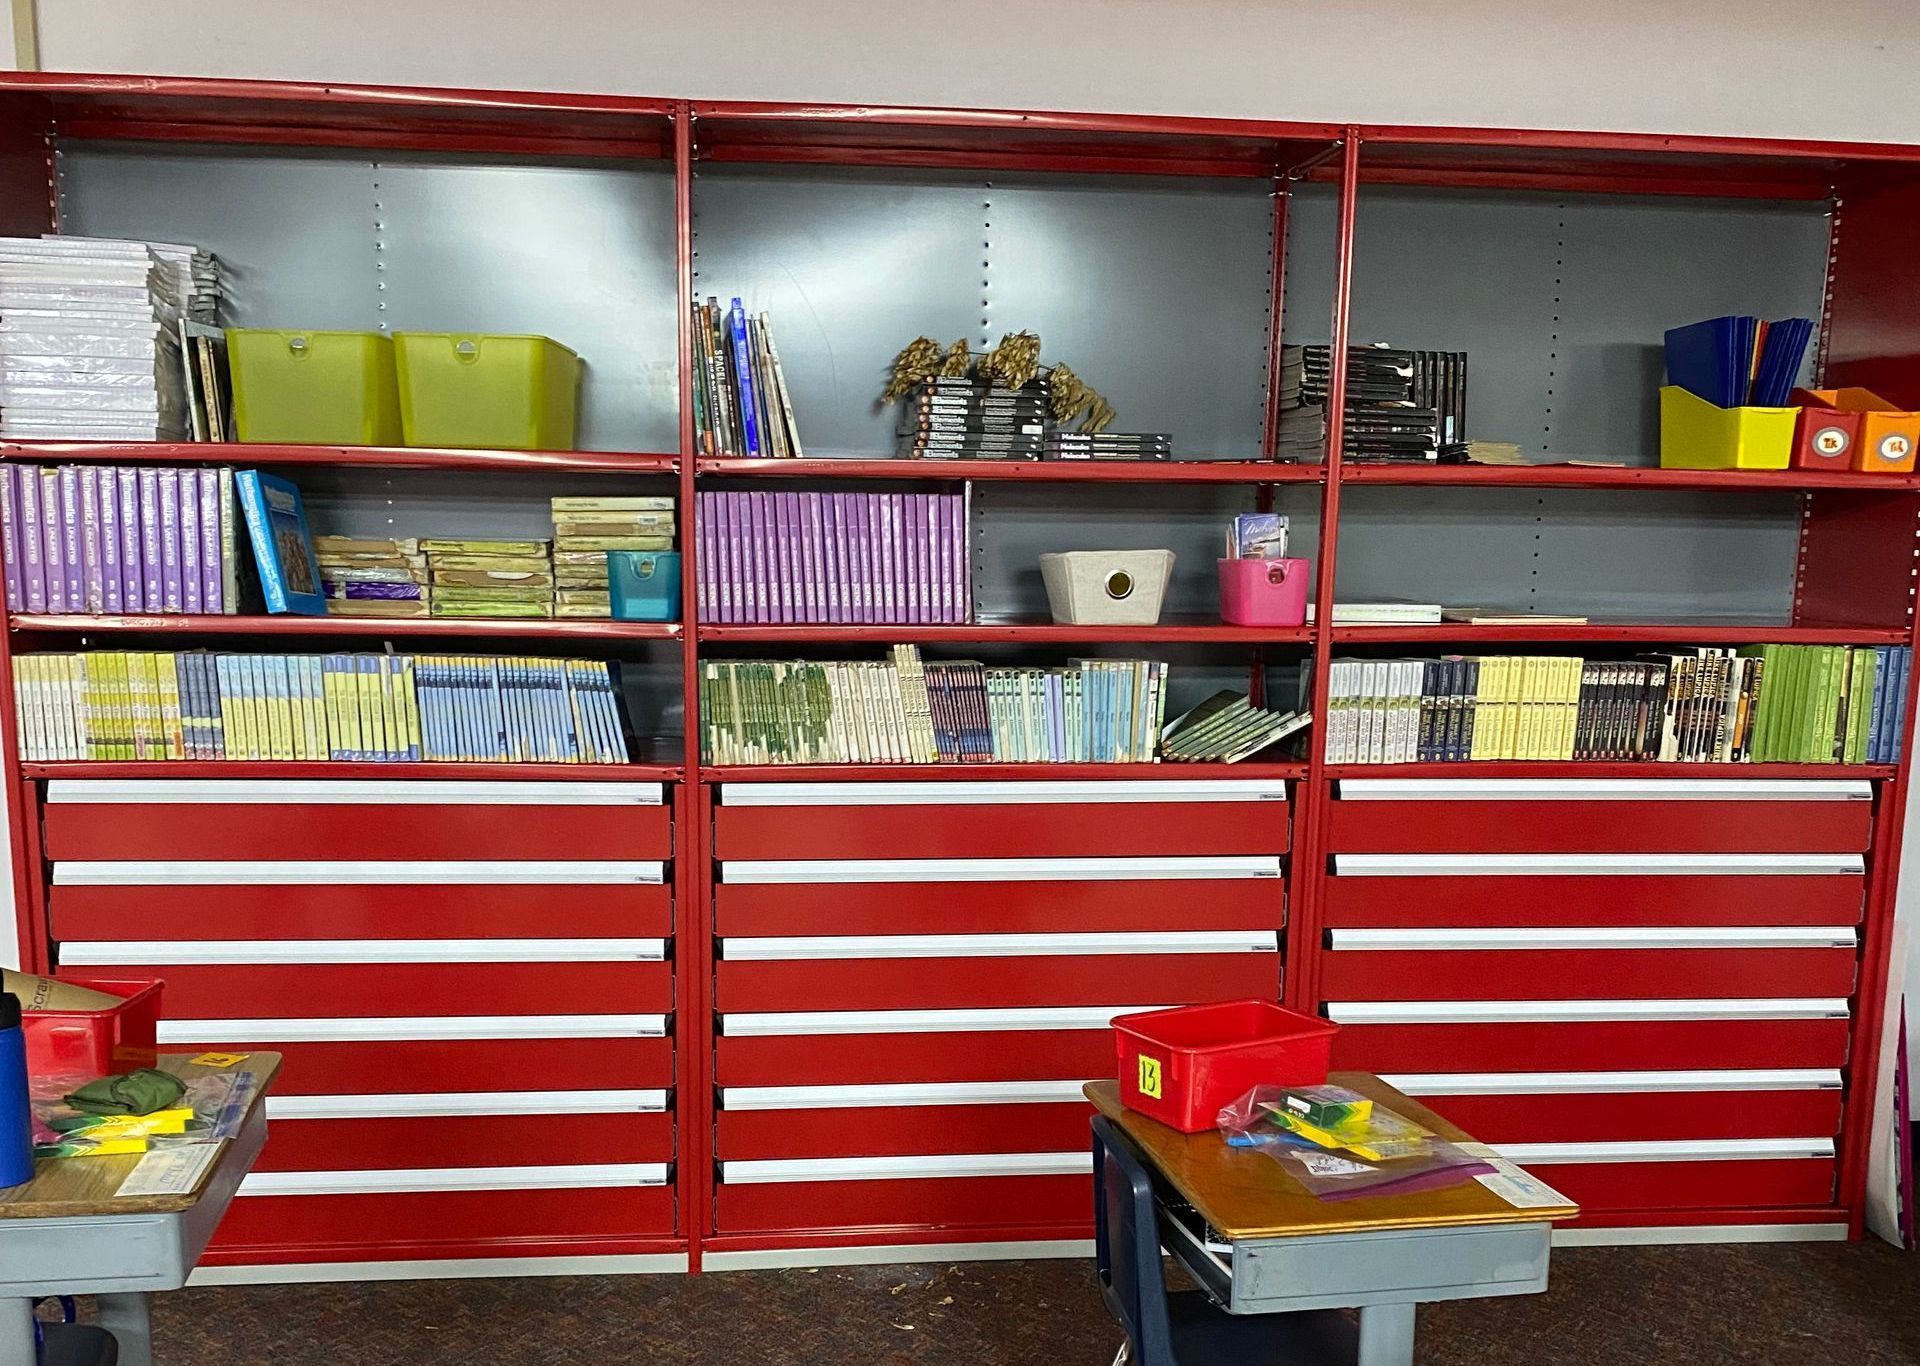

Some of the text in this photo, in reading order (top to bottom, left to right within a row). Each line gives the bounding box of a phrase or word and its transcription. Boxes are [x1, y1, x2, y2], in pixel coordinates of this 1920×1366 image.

[714, 350, 726, 381] SPACE!
[1694, 672, 1703, 698] LUPICA
[1702, 672, 1712, 699] LUPICA
[1709, 673, 1718, 699] LUPICA
[1752, 679, 1760, 701] LUPICA
[1141, 1061, 1156, 1093] 13
